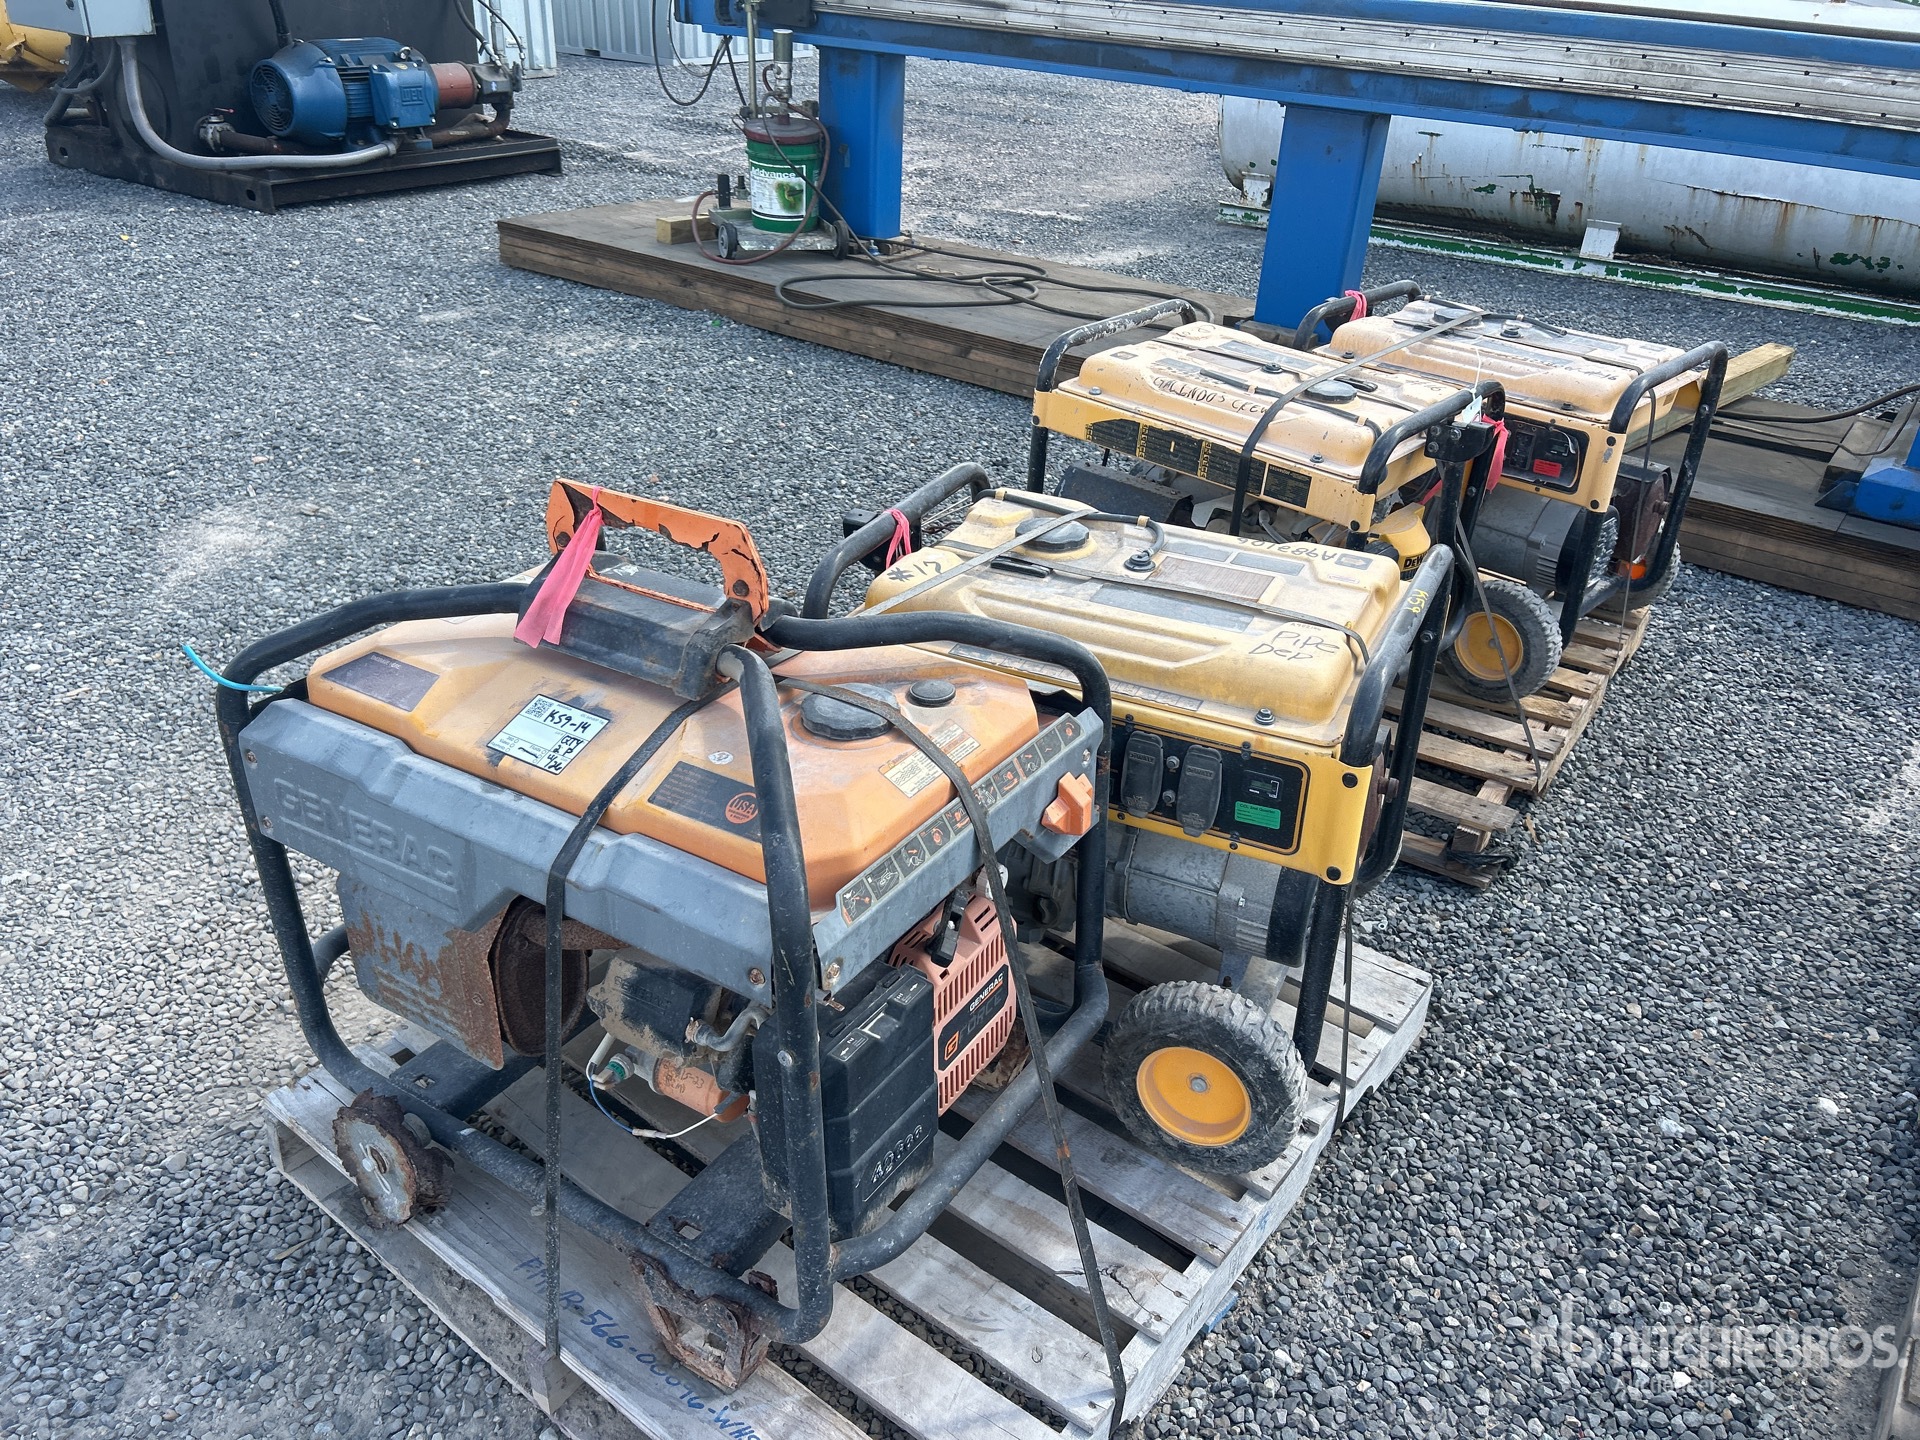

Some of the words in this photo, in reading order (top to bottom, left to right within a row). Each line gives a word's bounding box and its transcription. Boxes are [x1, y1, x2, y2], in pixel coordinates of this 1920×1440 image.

[543, 709, 591, 733] K59-14
[274, 778, 455, 884] GENERAC
[969, 973, 1004, 1012] GENERAC
